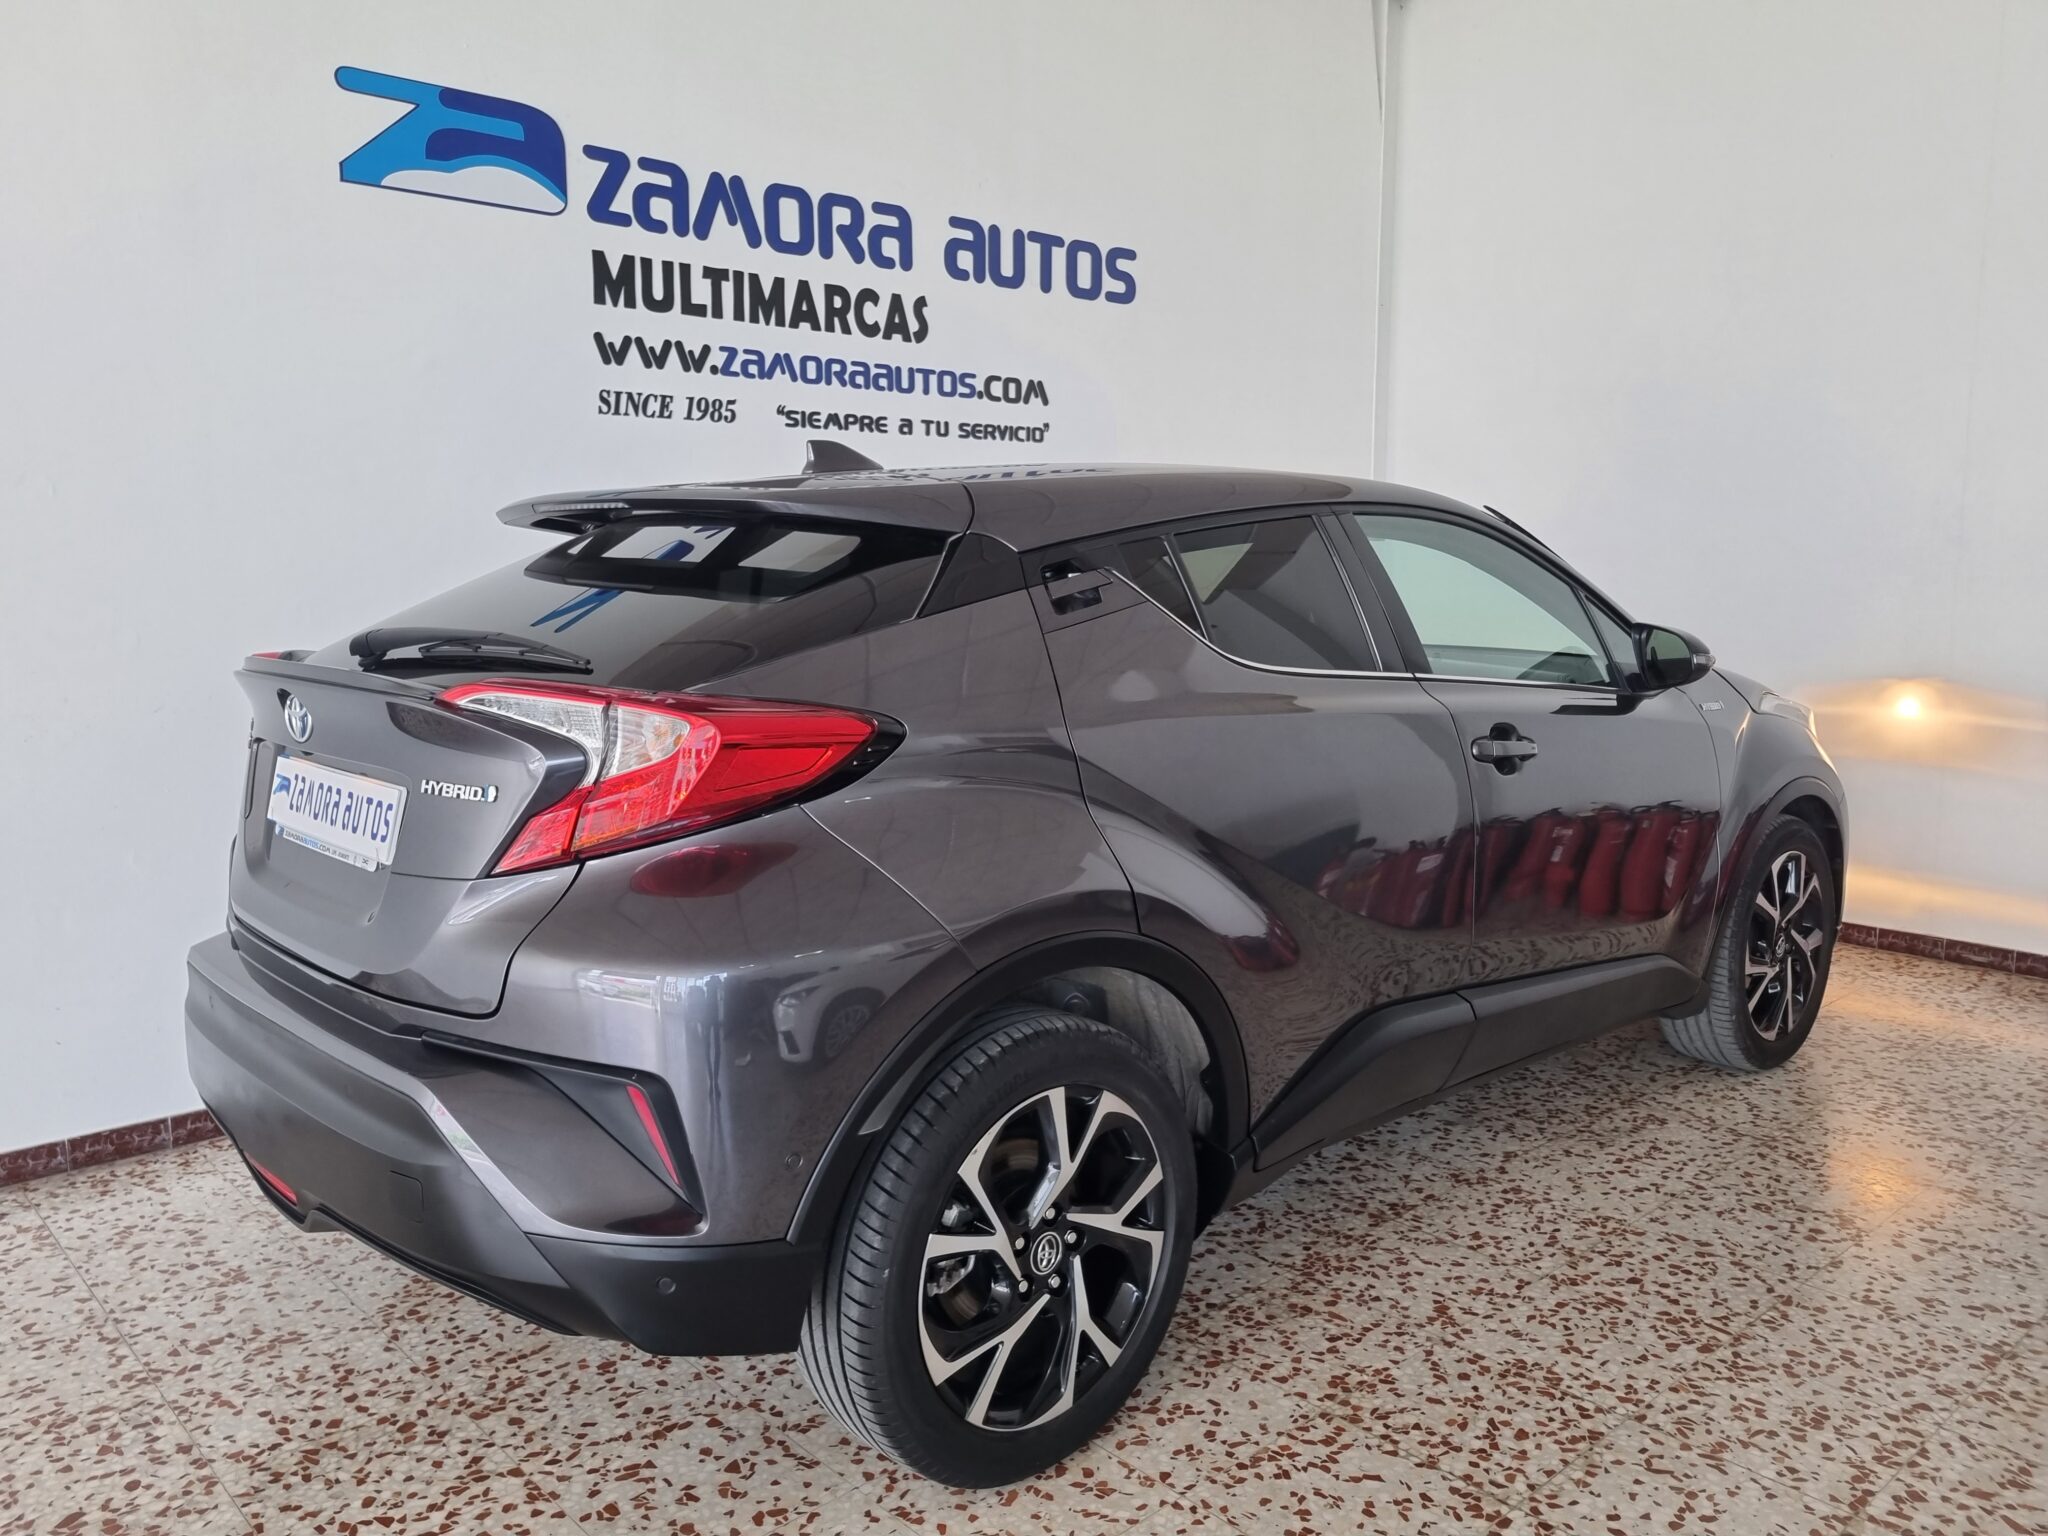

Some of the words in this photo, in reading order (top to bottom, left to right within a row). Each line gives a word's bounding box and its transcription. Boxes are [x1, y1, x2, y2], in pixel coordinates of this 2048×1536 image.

[591, 249, 929, 344] MULTIMARCAS
[597, 388, 674, 420] SINCE
[683, 396, 737, 424] 1985
[920, 419, 950, 438] TU
